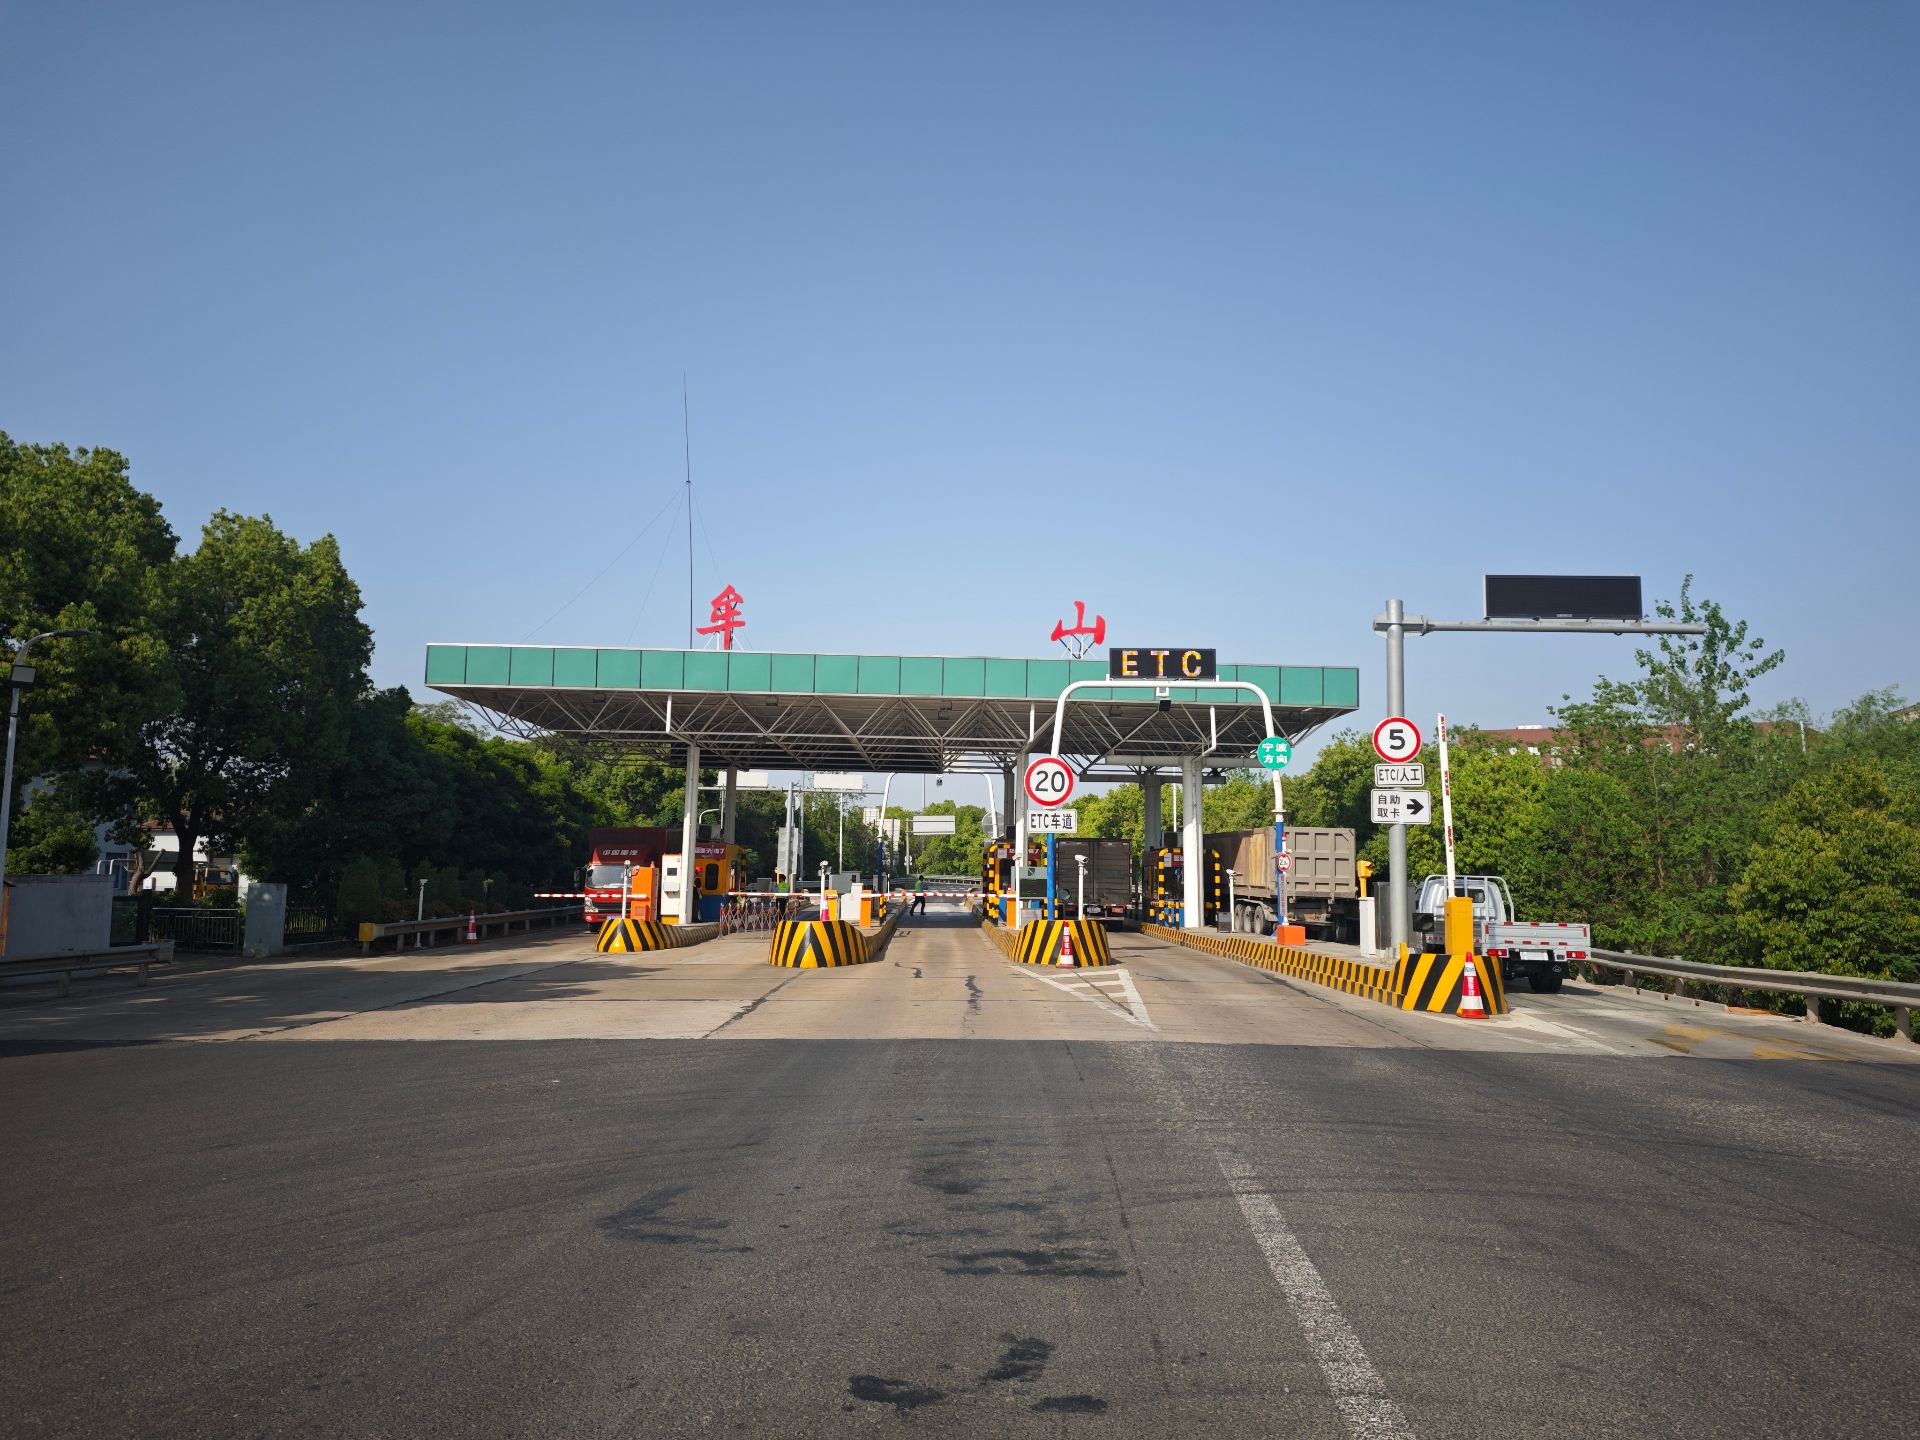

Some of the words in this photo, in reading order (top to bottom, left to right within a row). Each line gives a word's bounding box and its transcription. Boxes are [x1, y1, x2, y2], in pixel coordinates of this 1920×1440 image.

[1051, 601, 1106, 645] 山
[1121, 650, 1202, 677] ETC
[1389, 729, 1406, 750] 5
[1262, 743, 1287, 752] 宁波
[1263, 754, 1287, 764] 方向
[1035, 770, 1066, 793] 20
[1379, 767, 1420, 782] ETC/人工
[1378, 794, 1401, 805] 自助
[1378, 807, 1401, 818] 取卡
[1031, 813, 1073, 829] ETC车道
